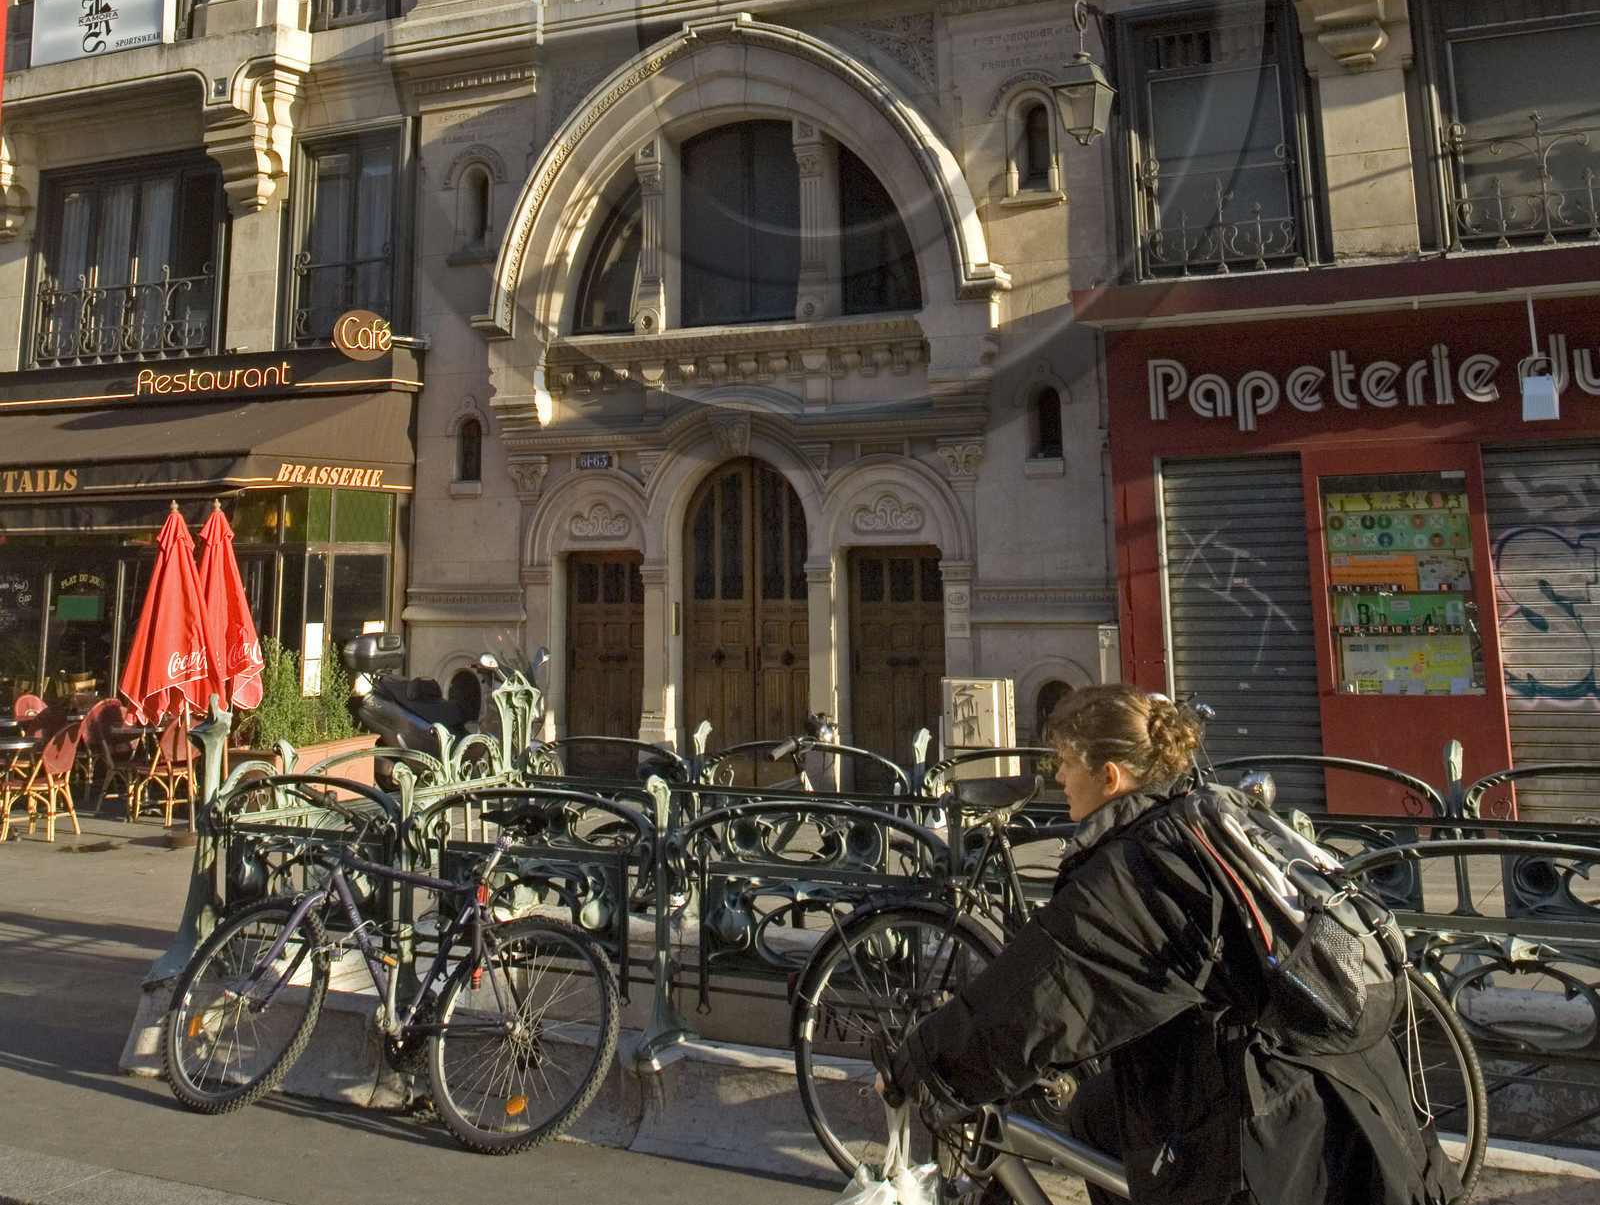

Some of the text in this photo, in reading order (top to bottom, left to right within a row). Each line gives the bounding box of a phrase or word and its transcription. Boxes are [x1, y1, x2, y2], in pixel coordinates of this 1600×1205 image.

[78, 10, 119, 25] KAMORA
[115, 32, 161, 48] SPORTSWEAR
[340, 316, 392, 351] Café
[136, 361, 291, 396] Restaurant
[1147, 343, 1500, 431] Papeterie
[2, 469, 78, 493] TAILS
[276, 463, 384, 488] BRASSERIE
[61, 575, 78, 589] PLAT
[79, 574, 89, 582] DU
